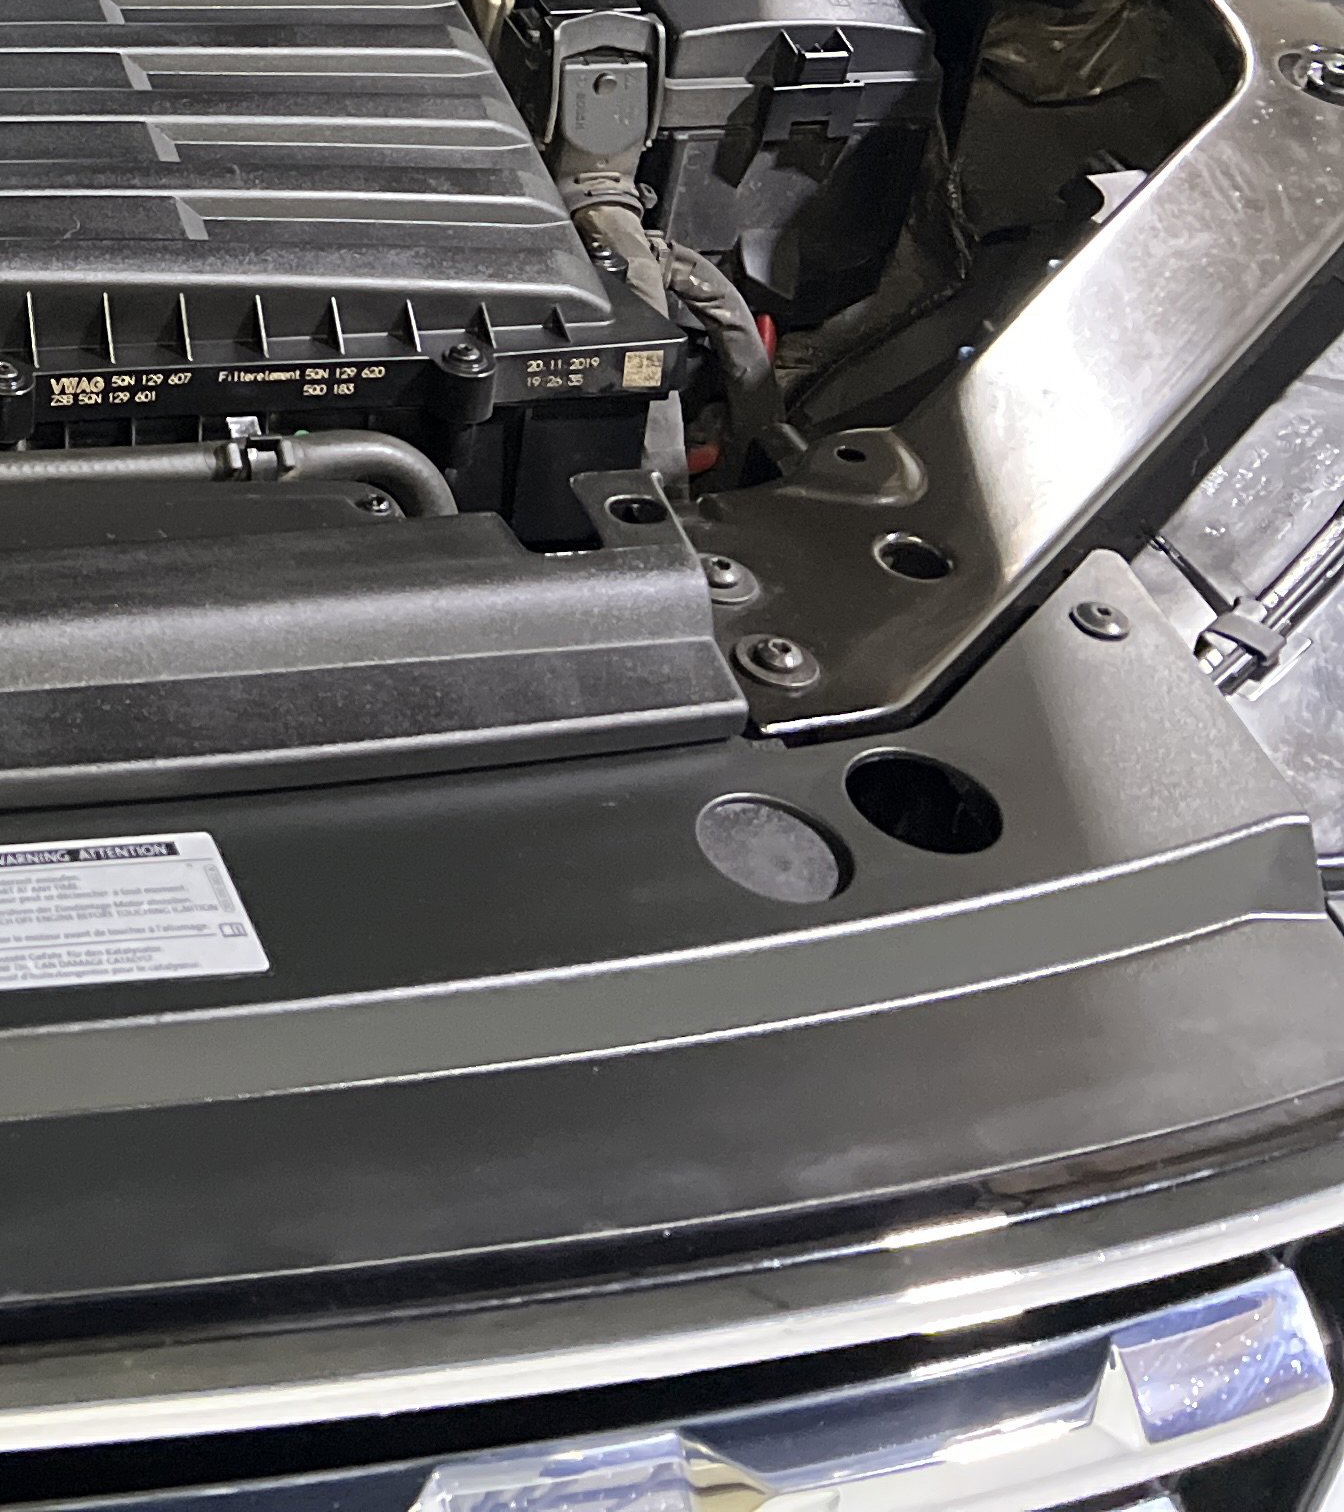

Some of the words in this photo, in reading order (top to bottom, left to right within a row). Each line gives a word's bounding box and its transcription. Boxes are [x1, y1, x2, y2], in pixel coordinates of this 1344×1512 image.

[142, 373, 164, 386] 129
[167, 372, 192, 385] 607
[335, 366, 358, 379] 129
[361, 366, 386, 378] 620
[333, 383, 355, 395] 183
[109, 391, 131, 403] 129
[134, 390, 156, 403] 601
[78, 842, 168, 861] ATTENTION
